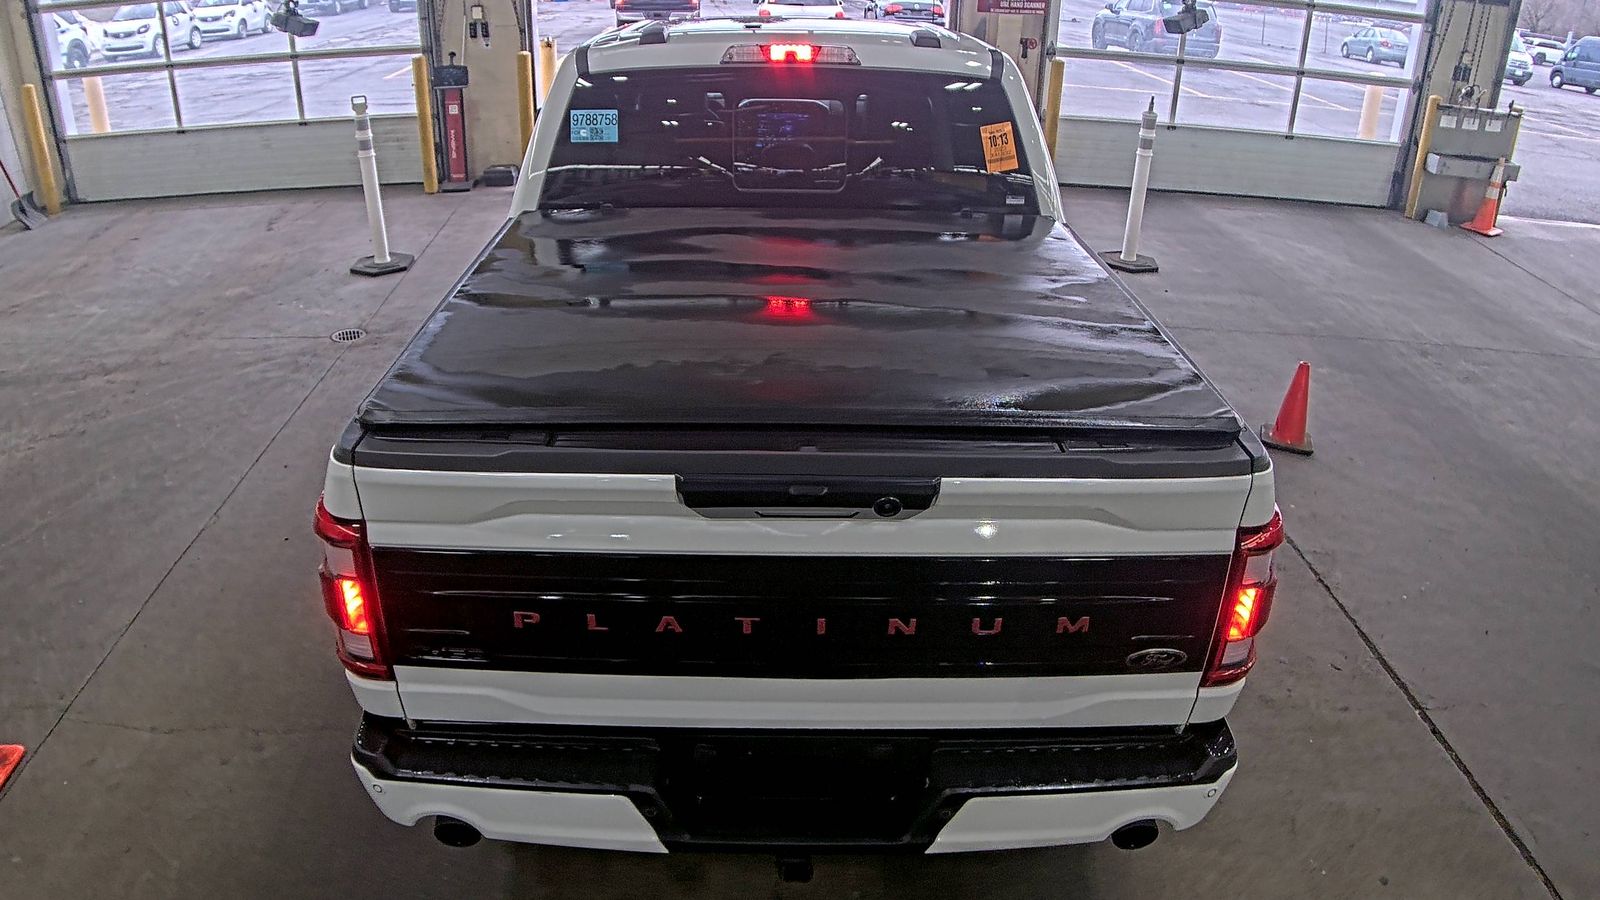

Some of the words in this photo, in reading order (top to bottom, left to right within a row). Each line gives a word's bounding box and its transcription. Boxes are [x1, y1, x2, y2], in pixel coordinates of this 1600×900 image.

[572, 113, 617, 126] 9788758
[988, 132, 1009, 148] 10:13
[513, 610, 1091, 636] PLATINUM
